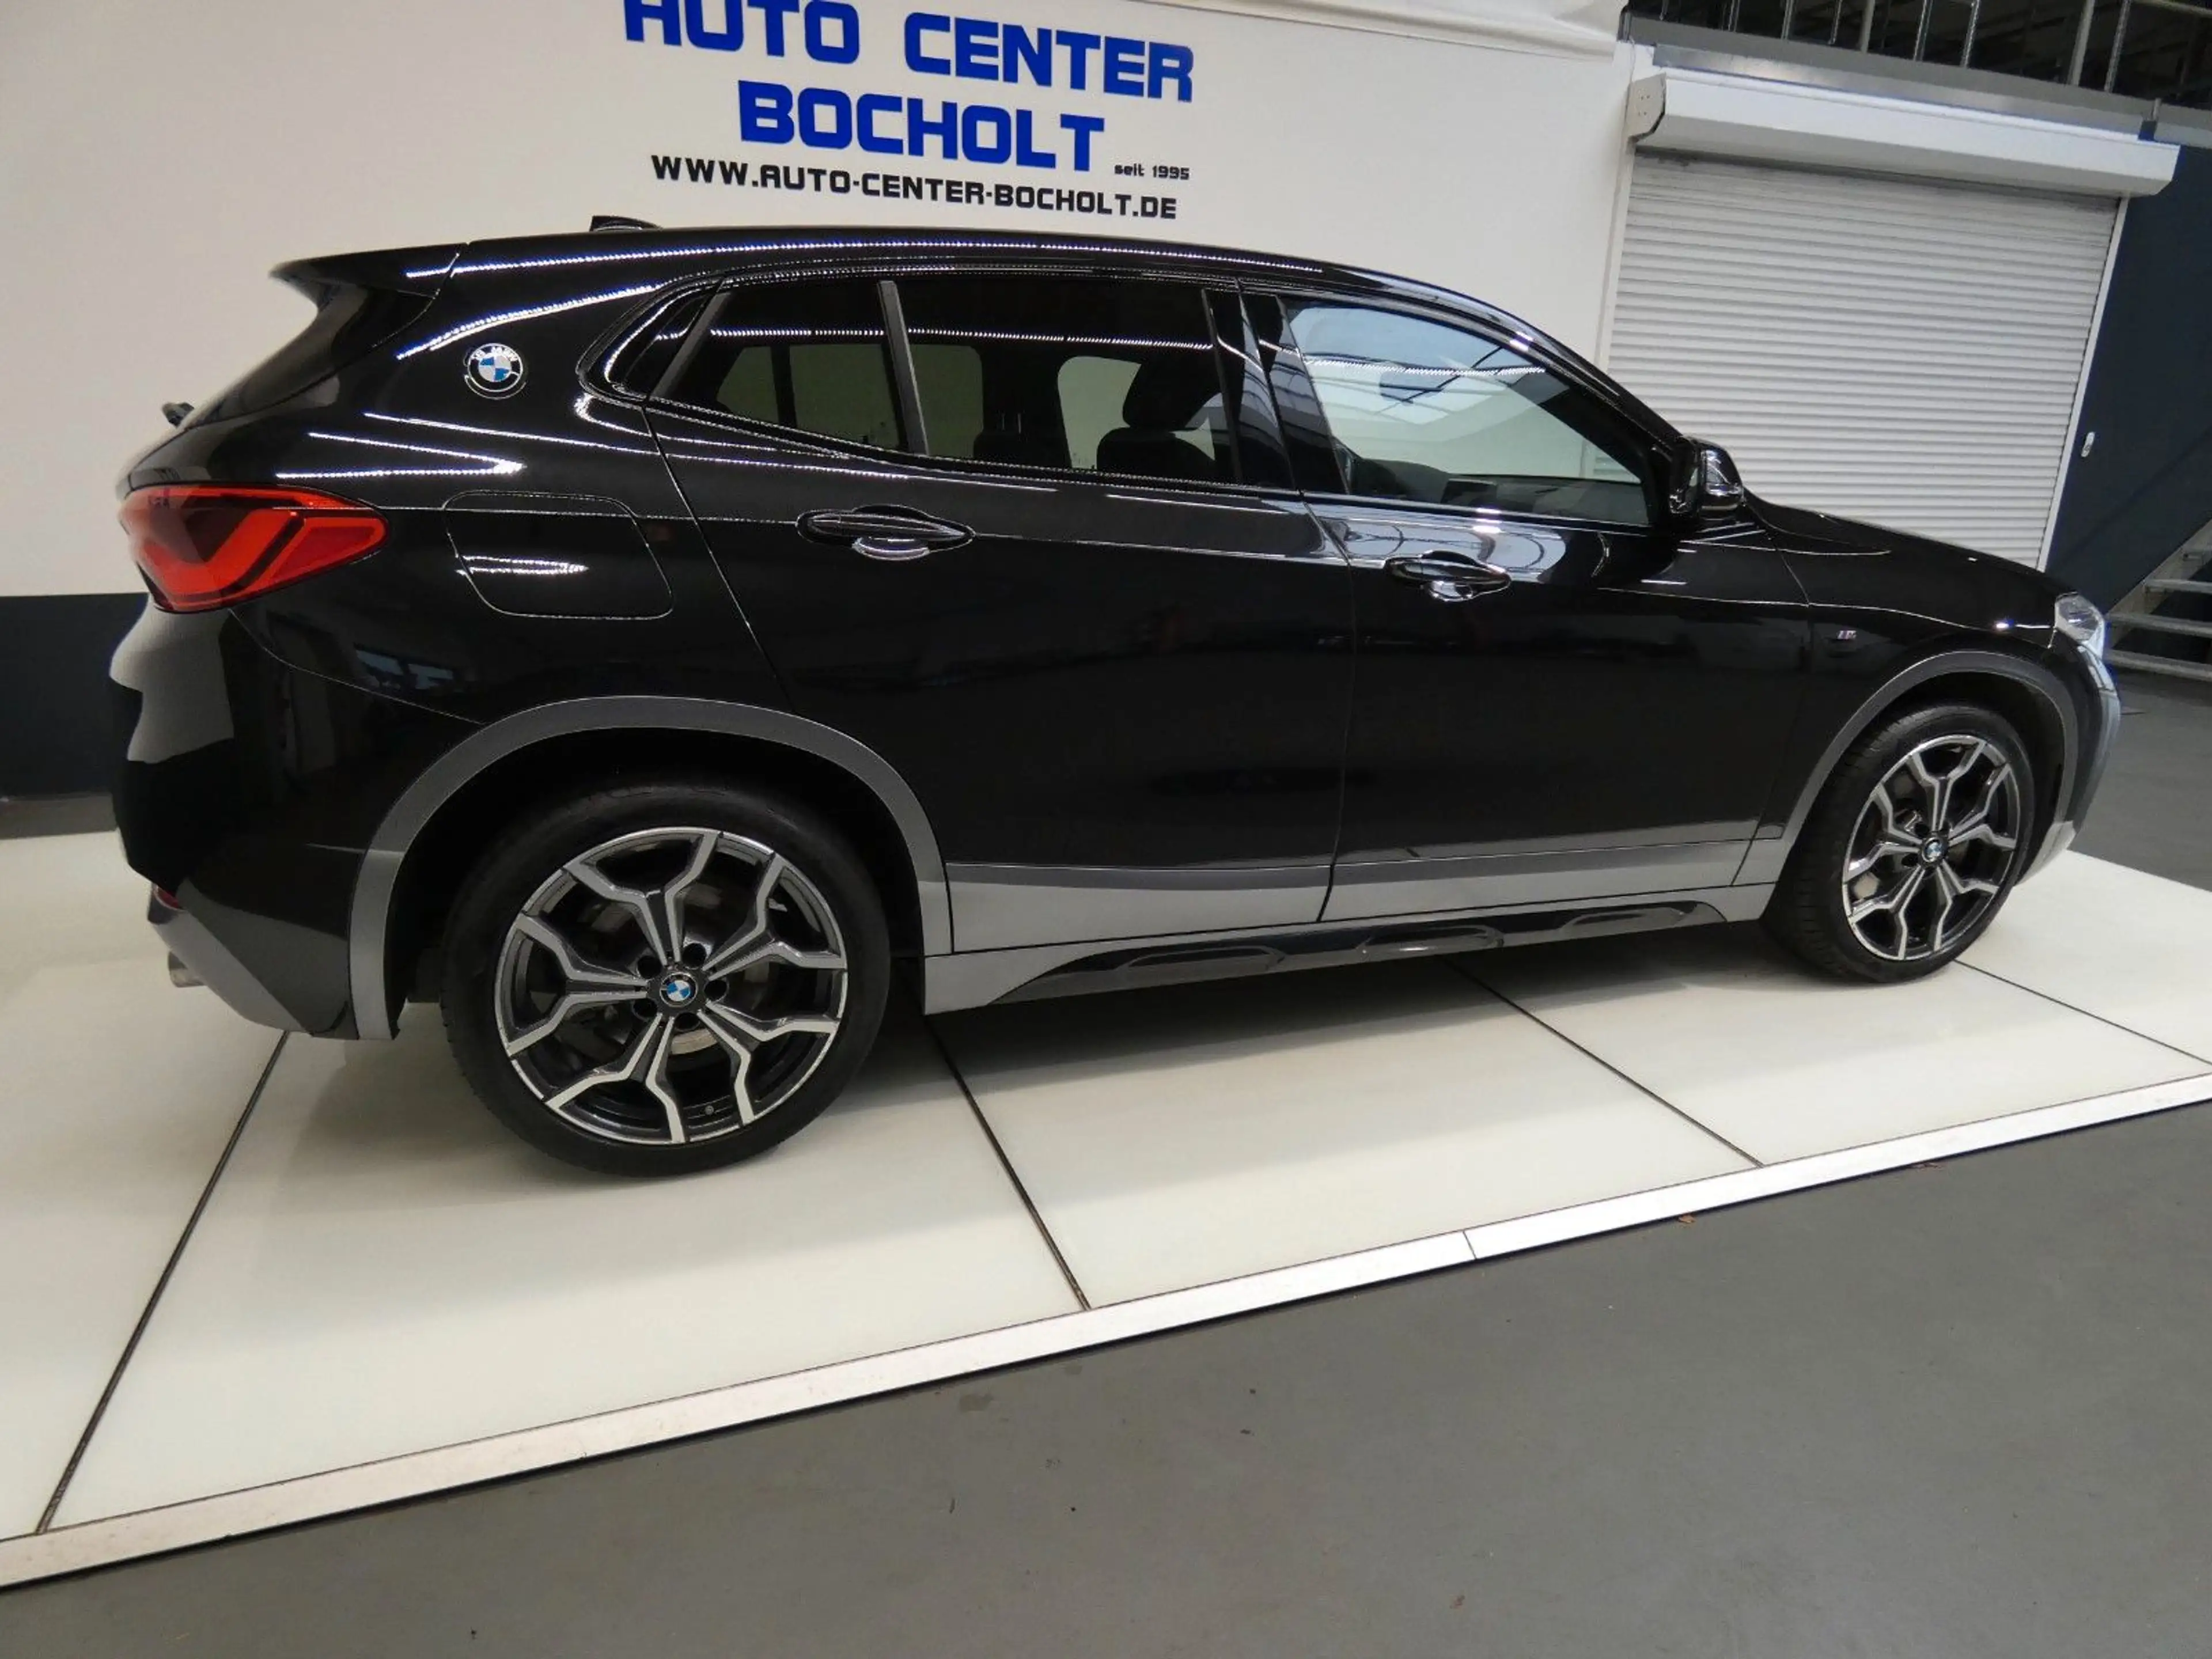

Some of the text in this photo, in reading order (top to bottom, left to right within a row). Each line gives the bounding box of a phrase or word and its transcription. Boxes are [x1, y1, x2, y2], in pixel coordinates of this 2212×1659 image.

[624, 0, 1194, 102] AUTO CENTER
[738, 79, 1105, 172] BOCHOLT
[651, 155, 1177, 220] WWW.AUTO-CENTER-BOCHOLT.DE
[1114, 163, 1190, 180] seit 1995
